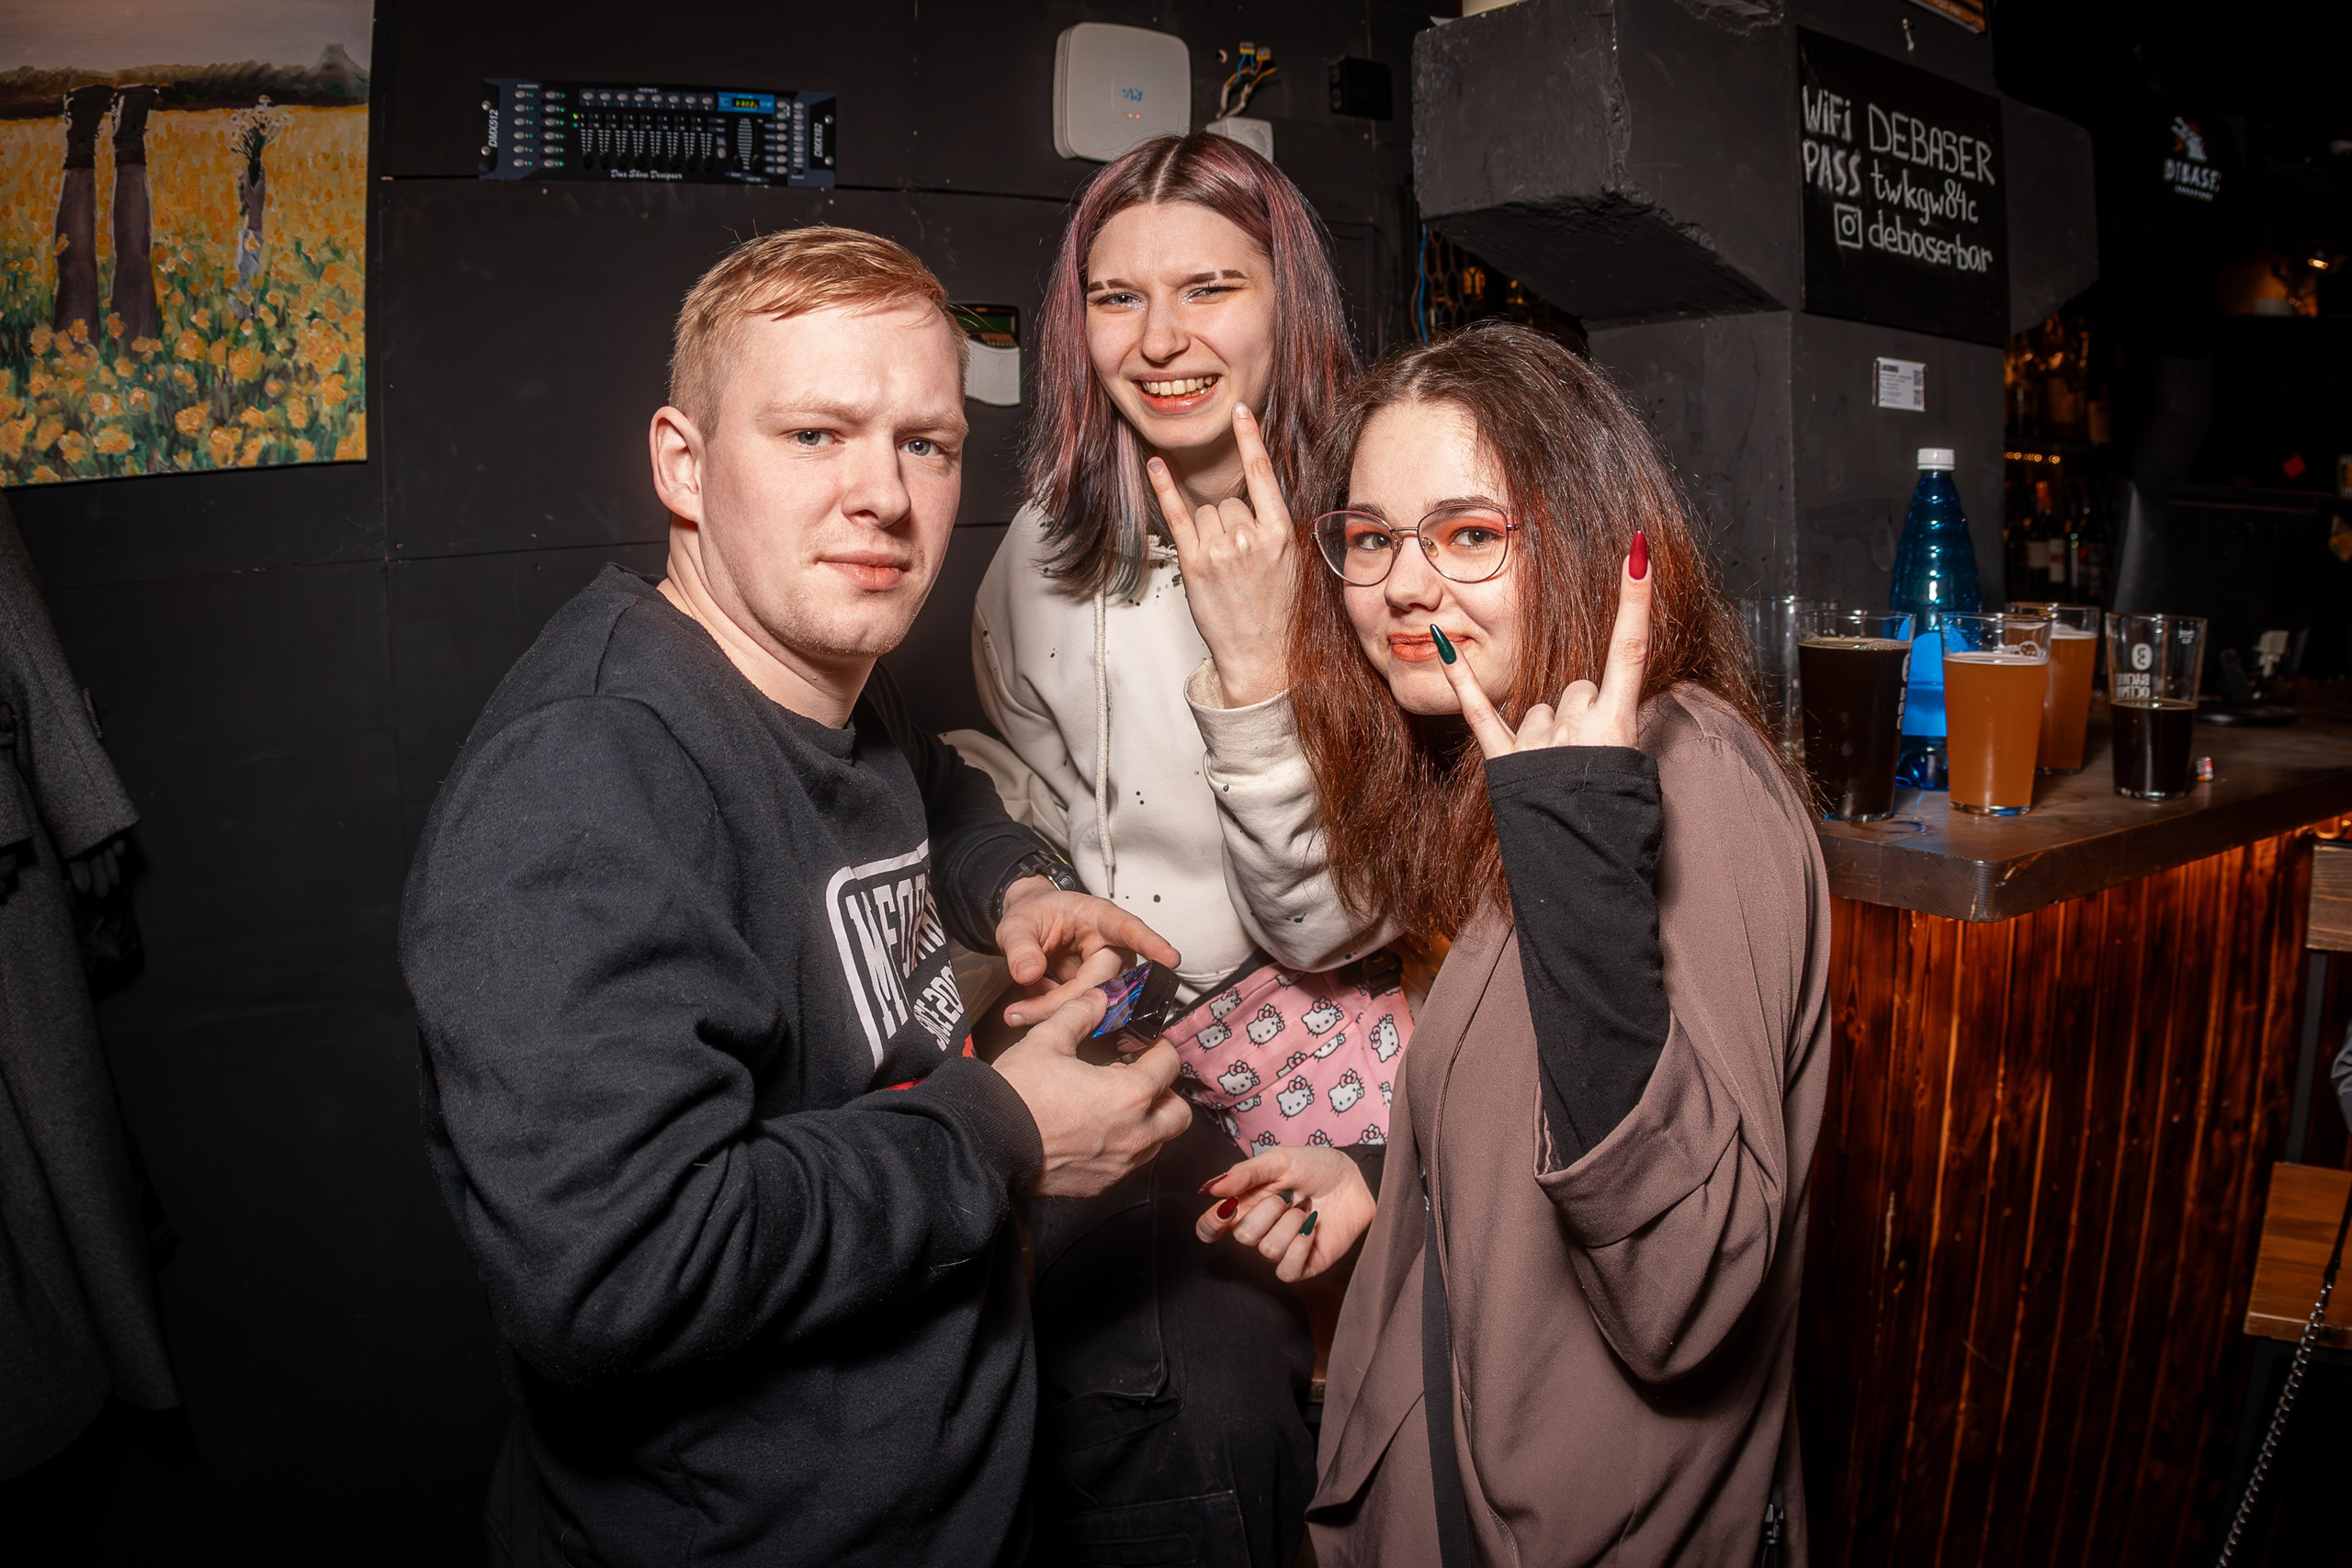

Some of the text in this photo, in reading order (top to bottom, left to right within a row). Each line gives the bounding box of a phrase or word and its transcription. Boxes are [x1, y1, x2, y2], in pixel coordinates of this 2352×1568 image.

[488, 108, 499, 148] DMX512
[813, 122, 823, 158] DMX192
[1803, 85, 1996, 186] WiFi DEBASER
[1802, 138, 1979, 226] PASS twkgw84c
[1868, 209, 1993, 273] debaserbar
